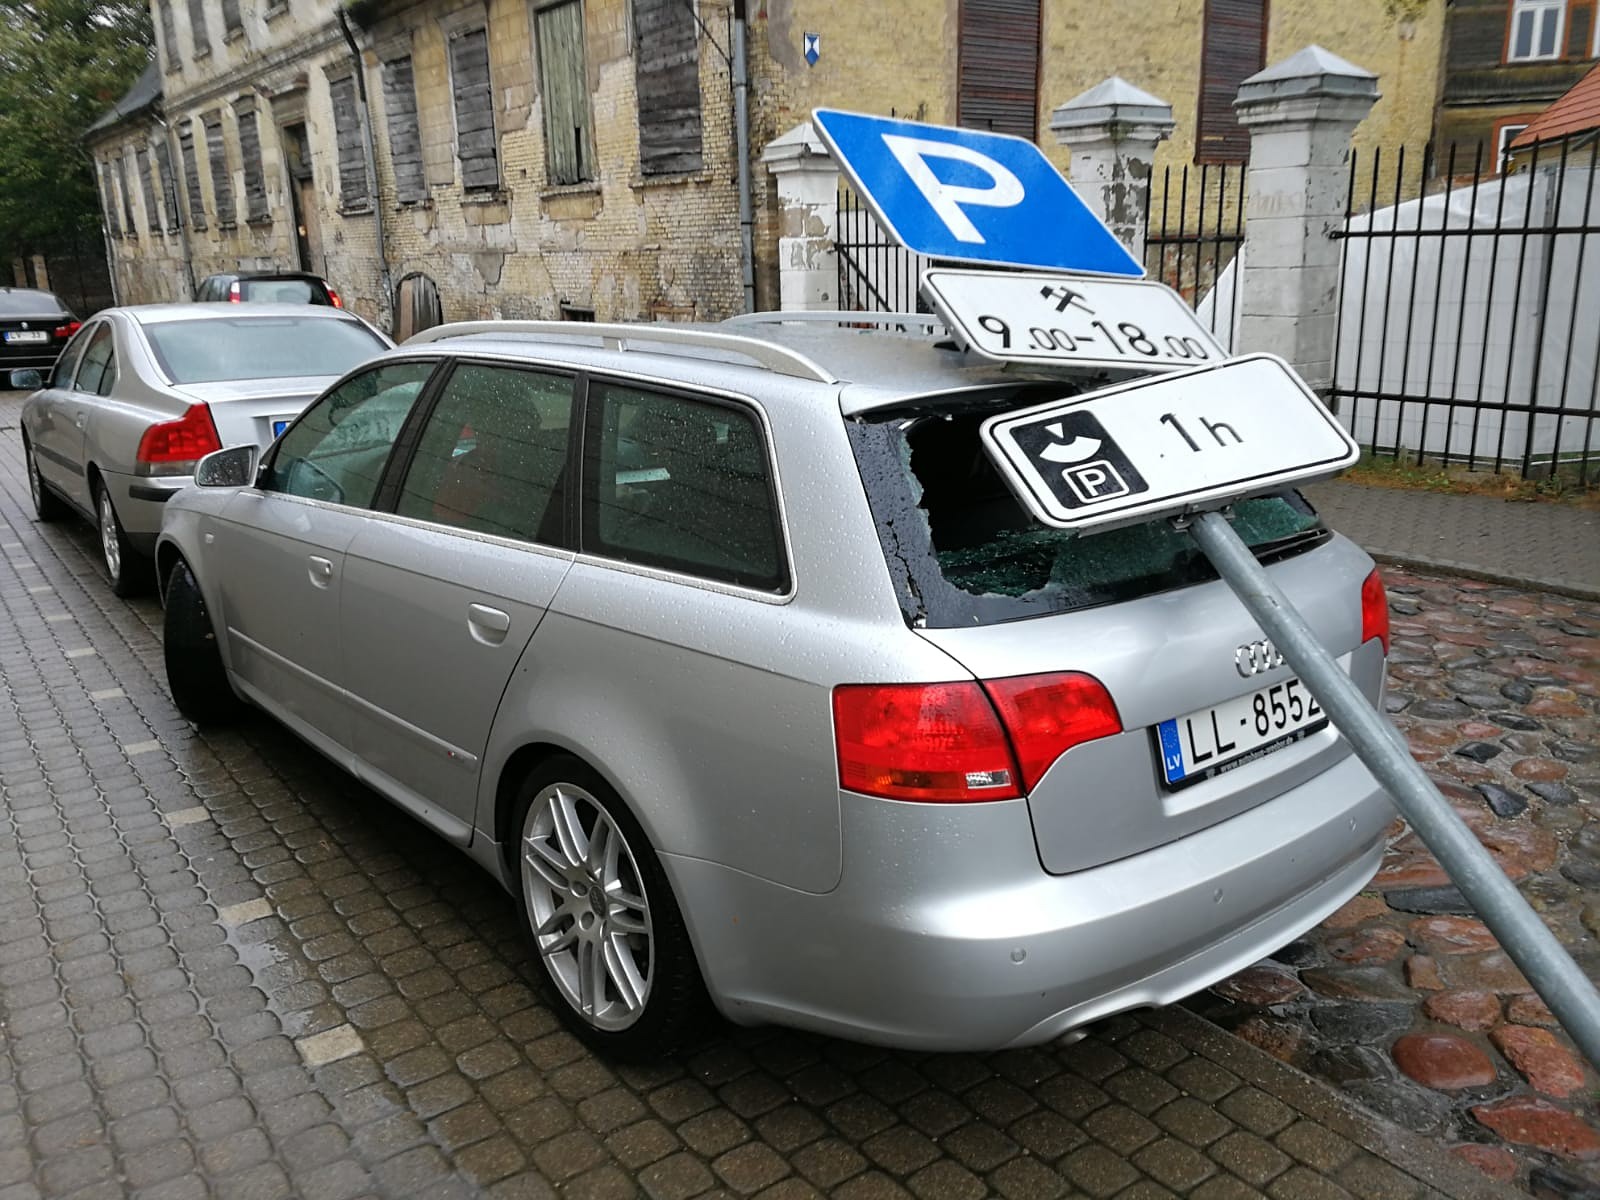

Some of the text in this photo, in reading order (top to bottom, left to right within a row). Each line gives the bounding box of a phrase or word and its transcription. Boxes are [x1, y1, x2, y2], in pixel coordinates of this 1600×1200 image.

[881, 133, 1025, 244] P
[1160, 413, 1244, 452] 1 h
[1076, 468, 1107, 498] P
[1167, 754, 1181, 770] LV
